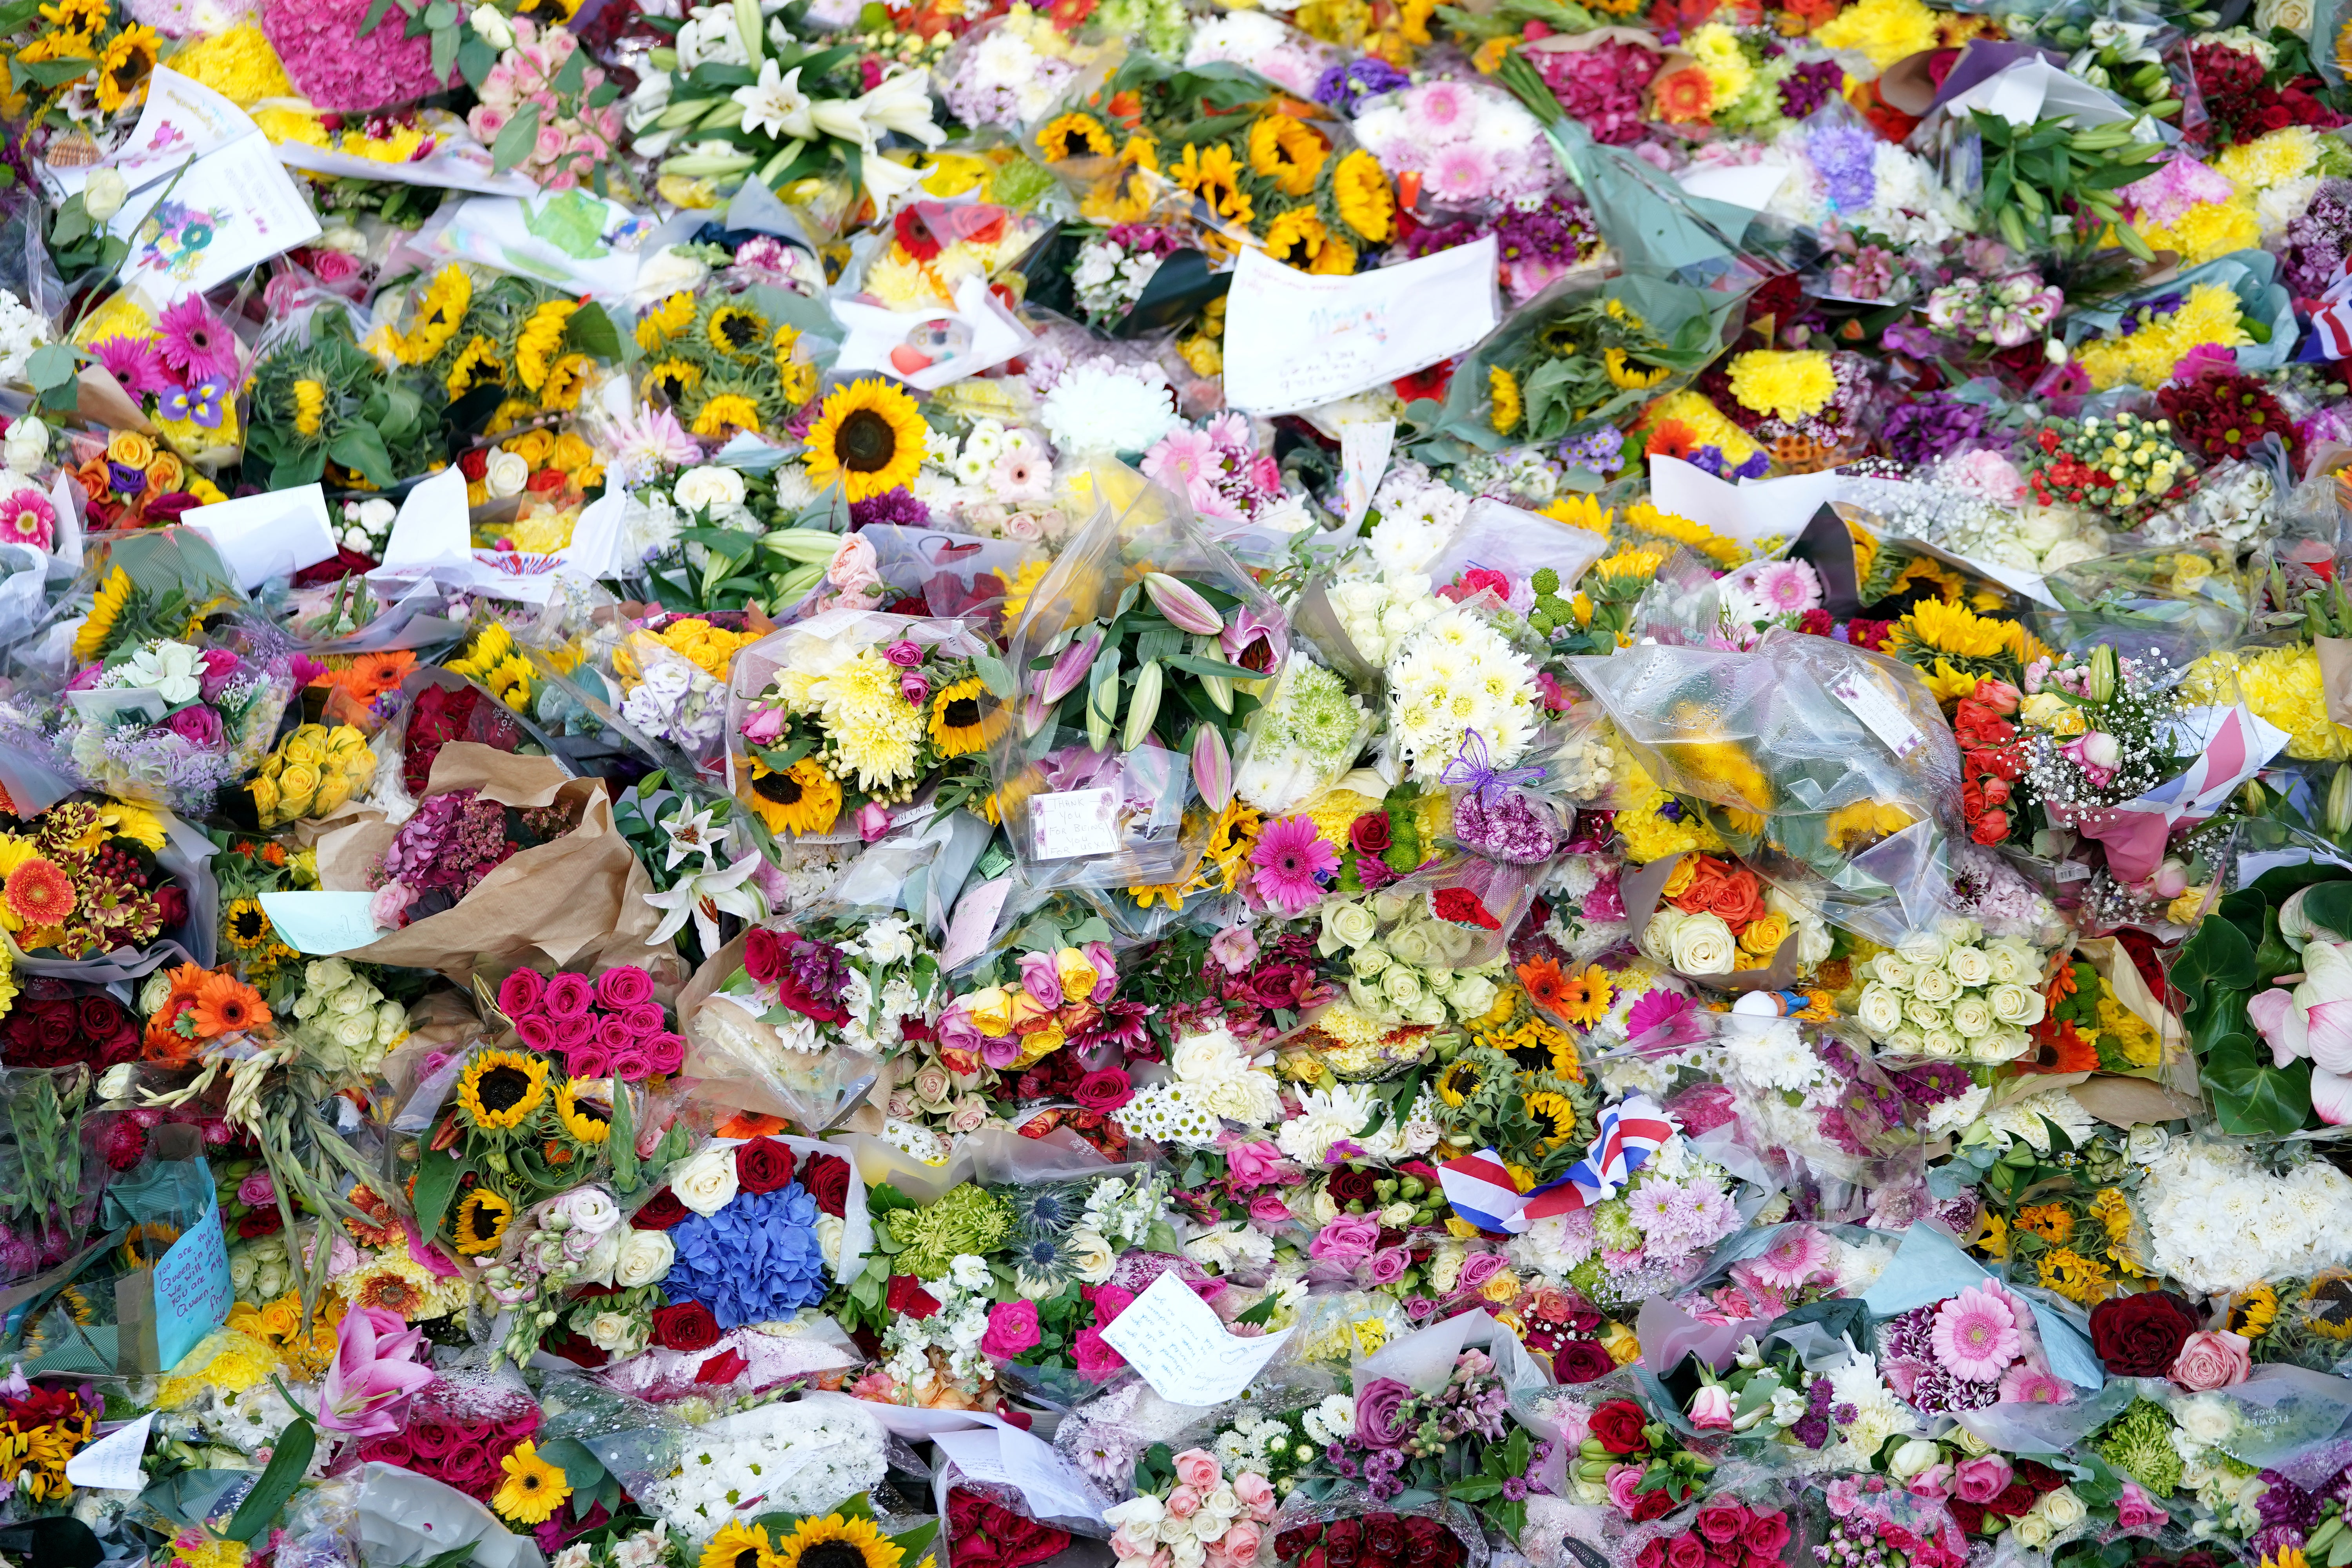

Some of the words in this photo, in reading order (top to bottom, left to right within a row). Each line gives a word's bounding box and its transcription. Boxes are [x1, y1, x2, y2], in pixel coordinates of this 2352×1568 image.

[1047, 798, 1085, 809] THANK
[1050, 826, 1067, 836] FOR
[1074, 823, 1105, 832] BEING
[177, 1246, 193, 1261] are
[184, 1263, 201, 1281] will
[208, 1236, 221, 1261] miss
[160, 1262, 190, 1292] Queen
[194, 1251, 203, 1261] in
[205, 1234, 215, 1250] the
[191, 1275, 205, 1290] are
[210, 1253, 223, 1273] my
[1152, 1292, 1167, 1305] you
[1167, 1308, 1175, 1316] as
[1129, 1315, 1142, 1328] you
[1140, 1313, 1154, 1325] and
[1125, 1328, 1138, 1339] you
[1145, 1332, 1157, 1342] all
[1180, 1321, 1198, 1341] much
[1138, 1342, 1154, 1357] that
[1181, 1338, 1196, 1357] hope
[1204, 1337, 1214, 1350] did
[1169, 1342, 1192, 1368] wanted
[1200, 1346, 1207, 1355] as
[1135, 1359, 1151, 1373] your
[1161, 1364, 1173, 1378] hope
[1154, 1378, 1168, 1396] Dear
[1188, 1383, 1211, 1393] you
[2253, 1407, 2276, 1416] SHOP
[2243, 1414, 2288, 1427] FLOWER
